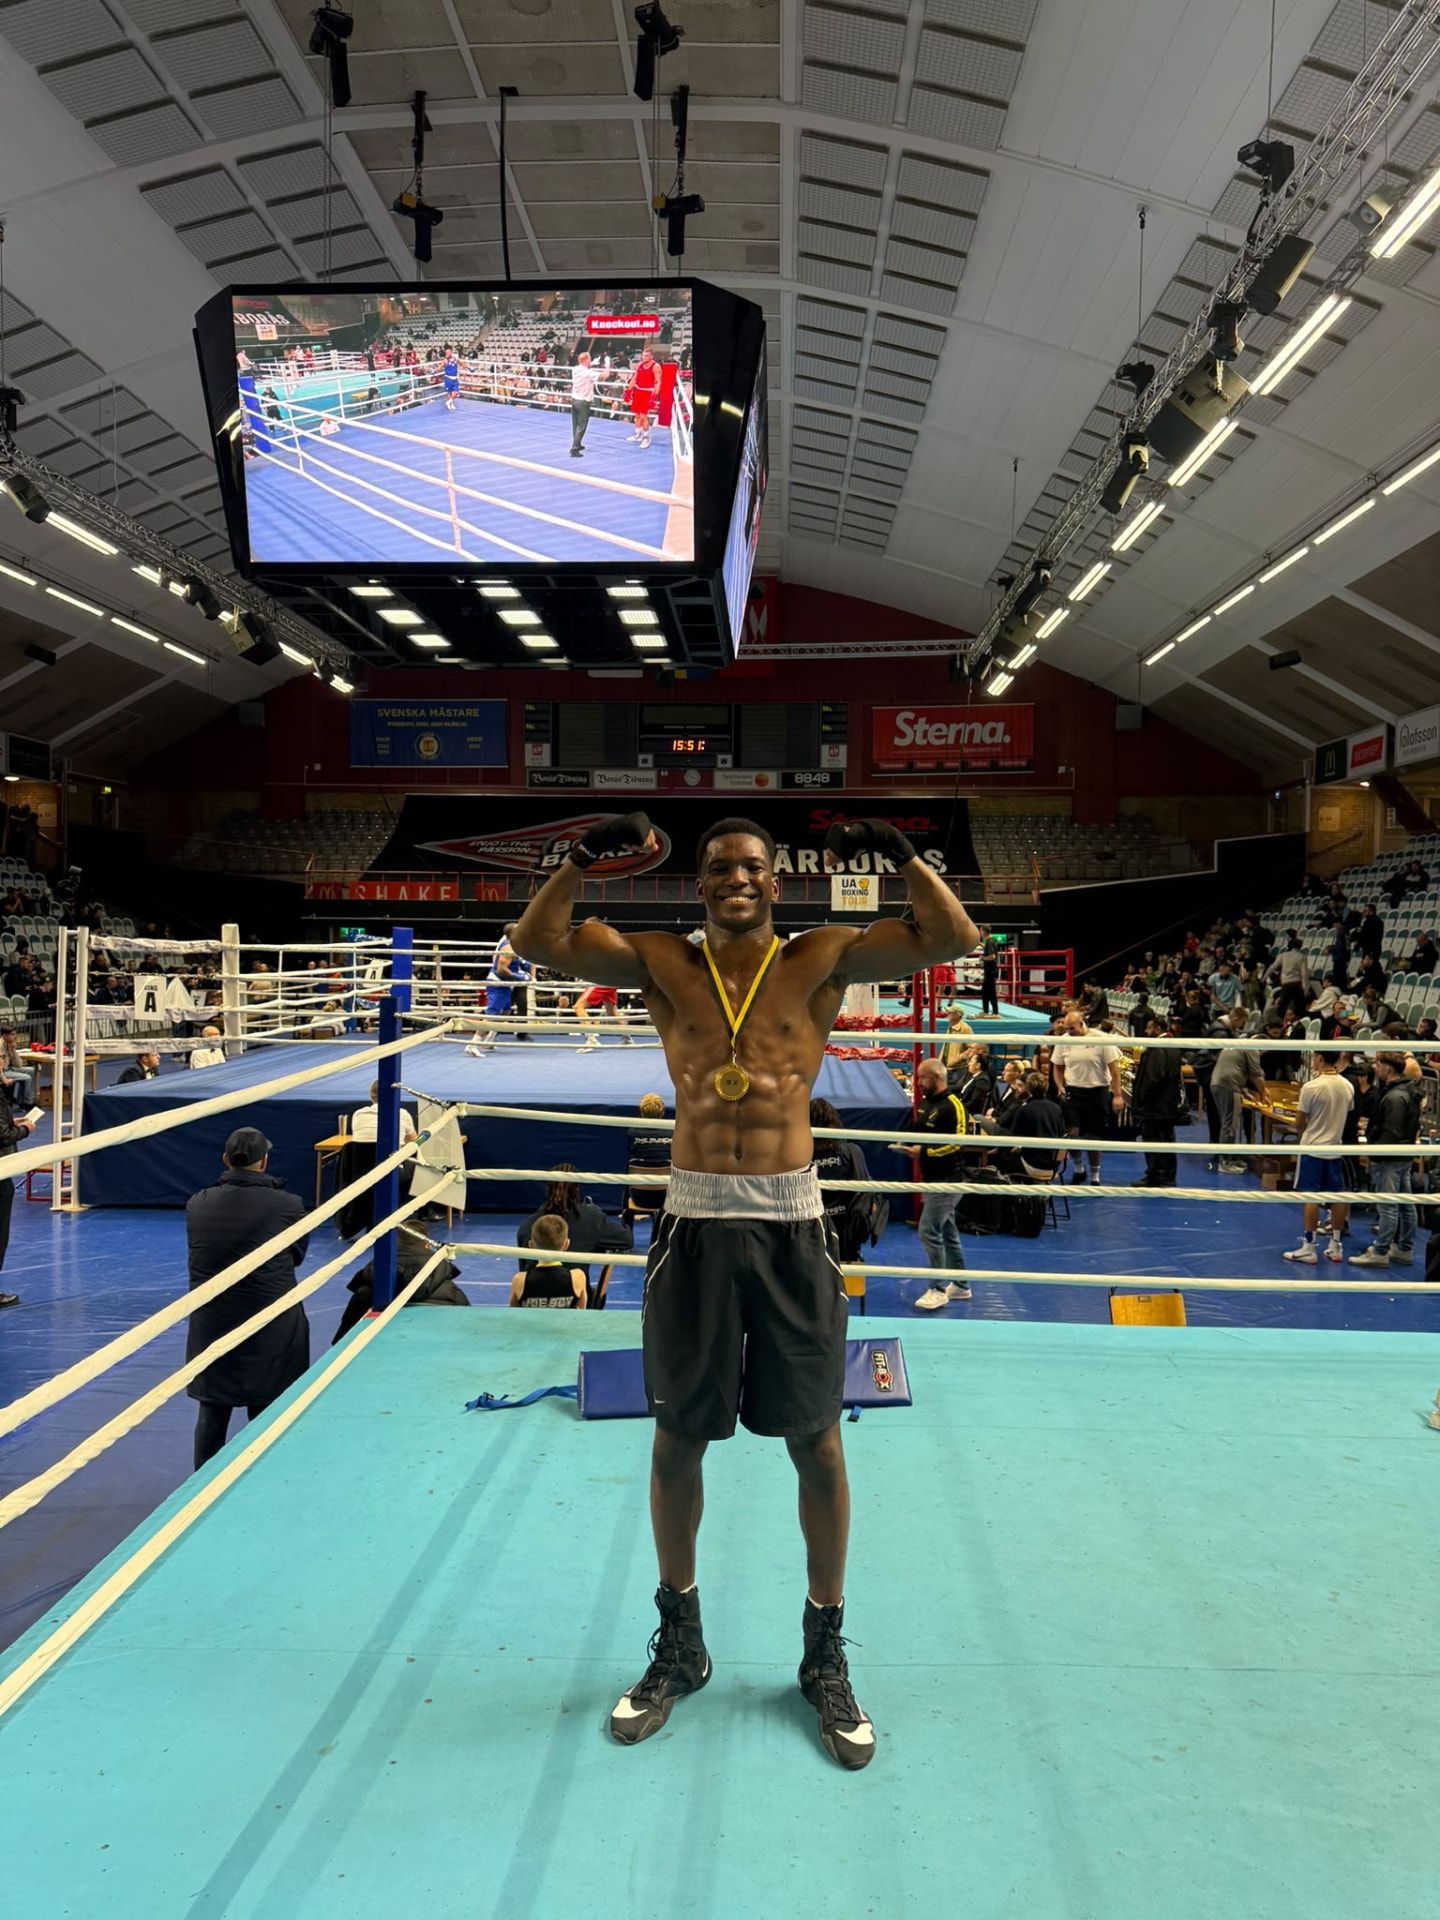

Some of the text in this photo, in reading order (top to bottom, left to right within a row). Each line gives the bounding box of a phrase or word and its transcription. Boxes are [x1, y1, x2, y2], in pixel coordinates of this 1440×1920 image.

[591, 319, 656, 329] Knockout.no
[377, 706, 480, 718] SVENSKA MÄSTARE
[893, 711, 1011, 747] Sterna.
[794, 772, 831, 784] 8848
[841, 879, 857, 888] UA
[841, 889, 869, 897] BOXING
[842, 897, 868, 906] TOUR
[144, 992, 157, 1012] A
